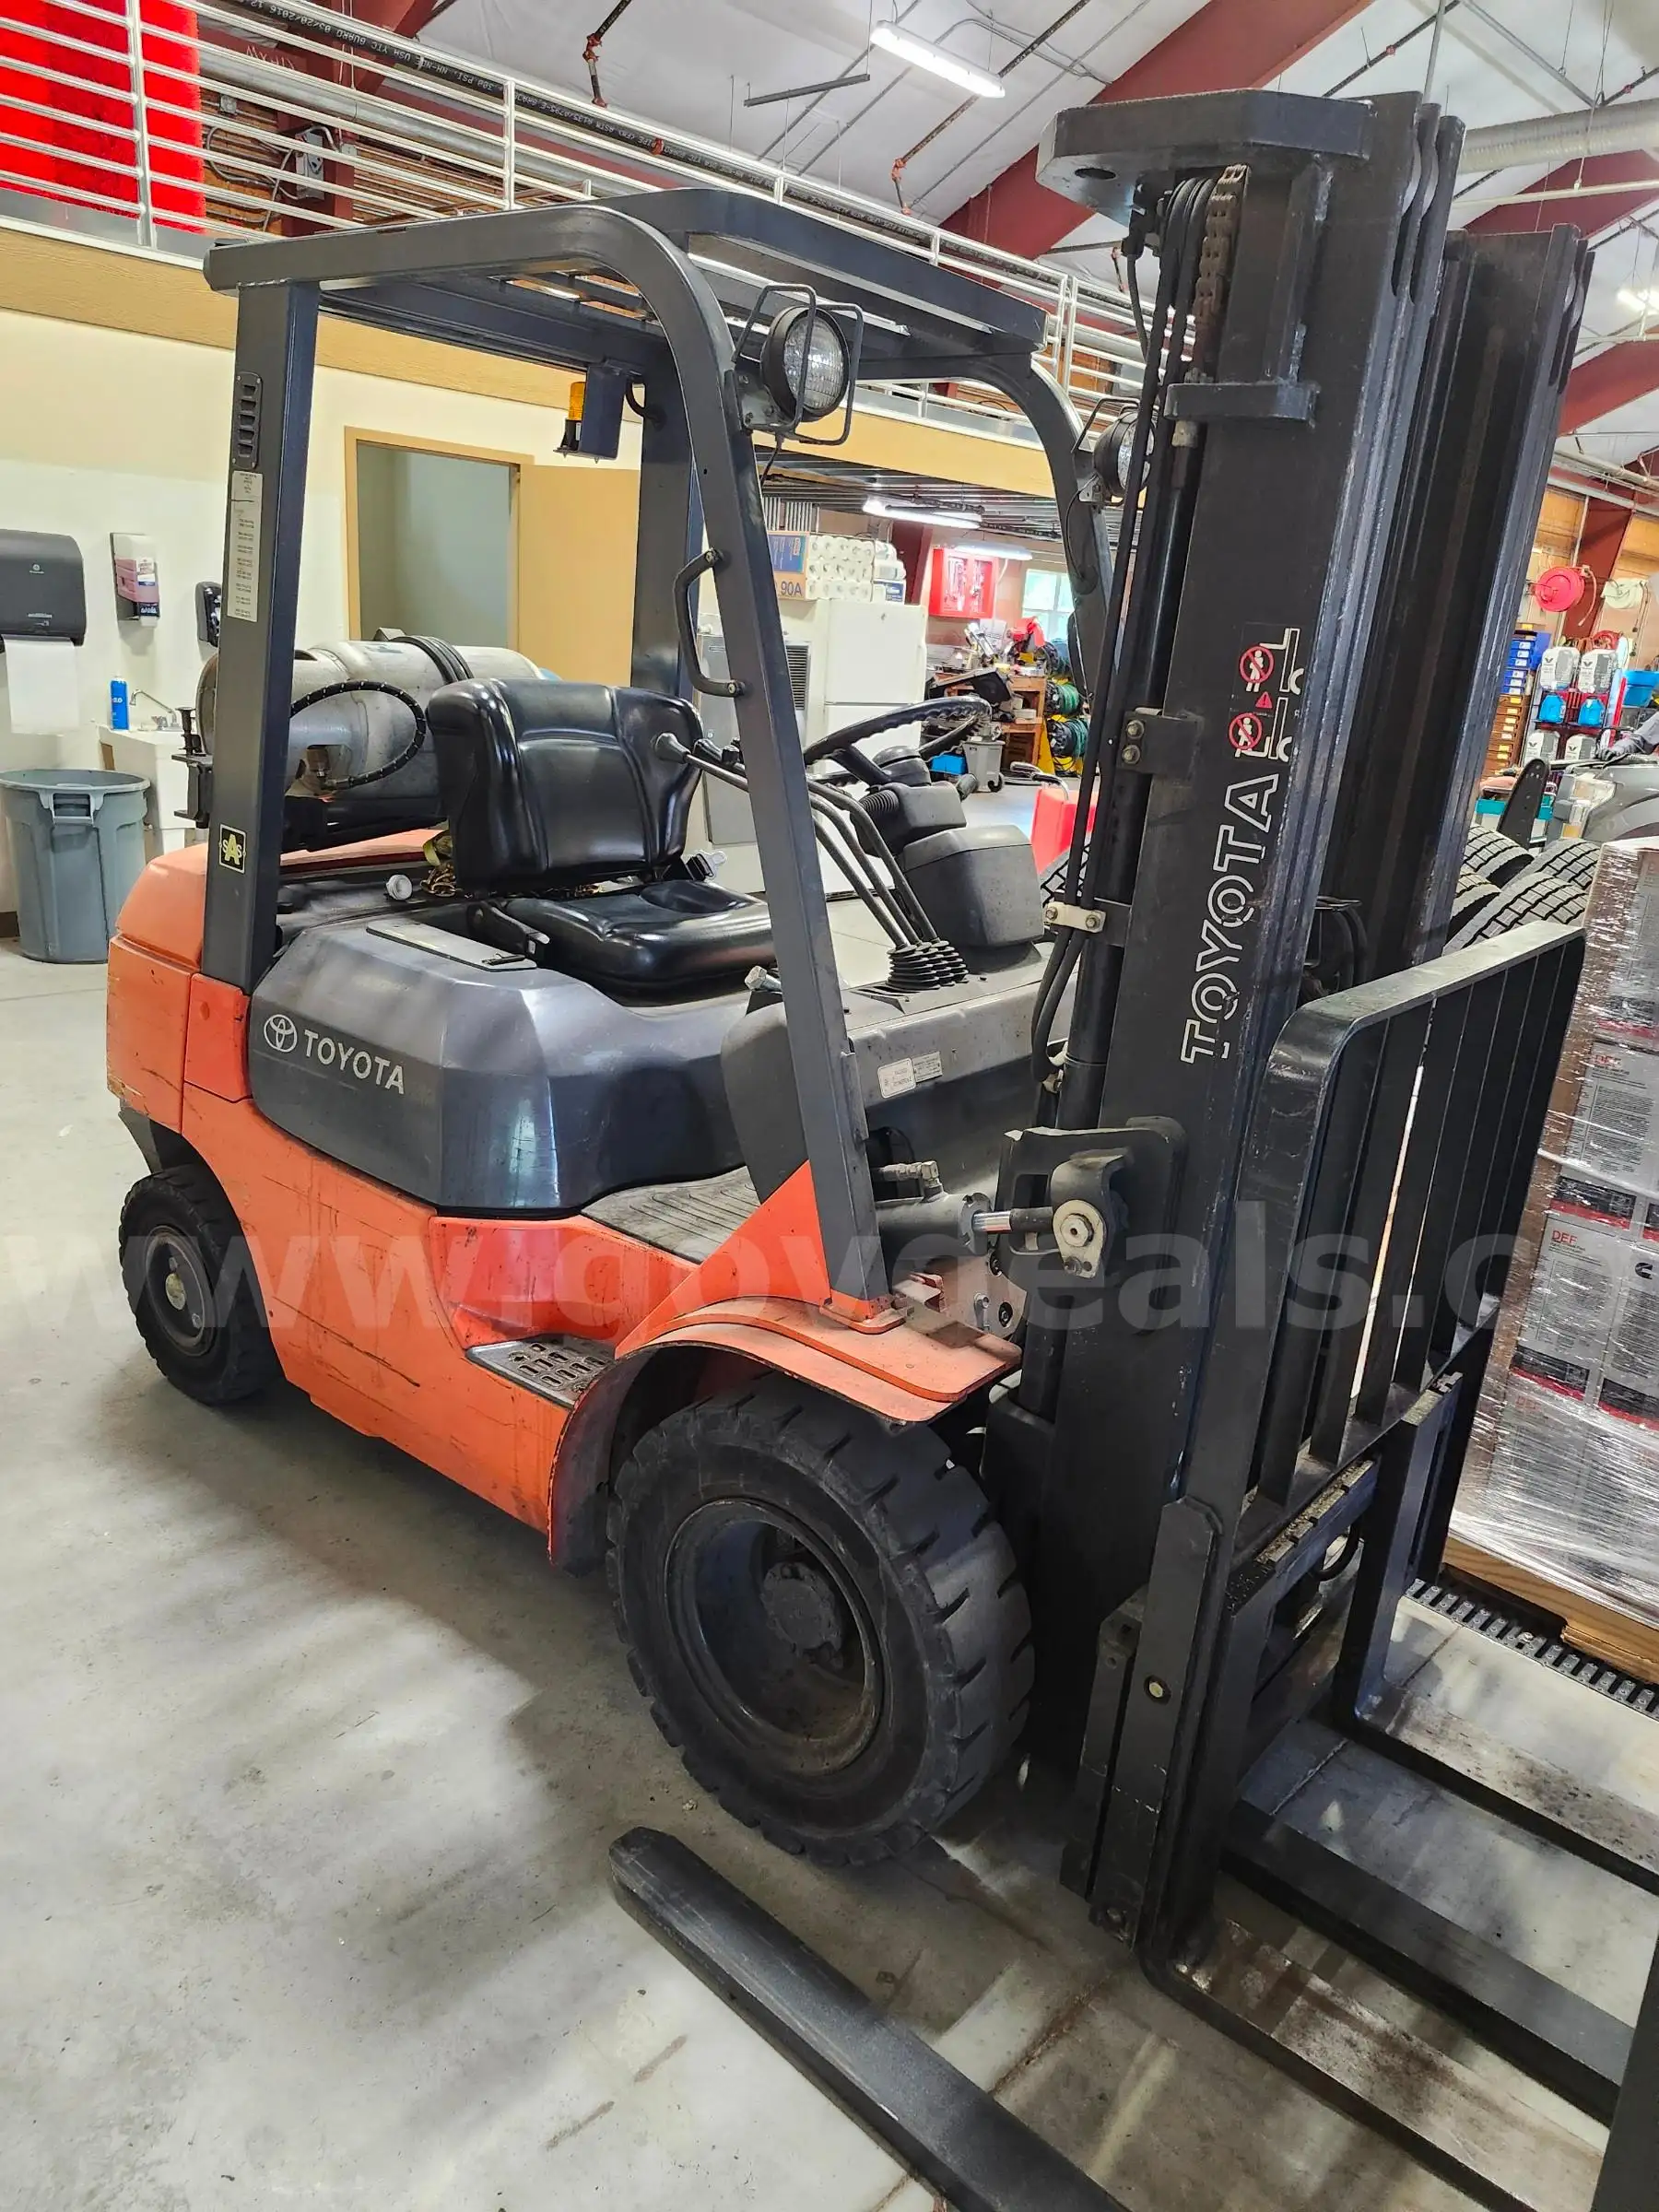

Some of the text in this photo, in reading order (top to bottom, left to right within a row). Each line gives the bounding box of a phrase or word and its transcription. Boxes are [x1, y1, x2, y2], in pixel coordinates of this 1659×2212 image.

[1181, 772, 1280, 1064] TOYOTA
[304, 1029, 406, 1095] TOYOTA
[1552, 1230, 1577, 1244] DEF
